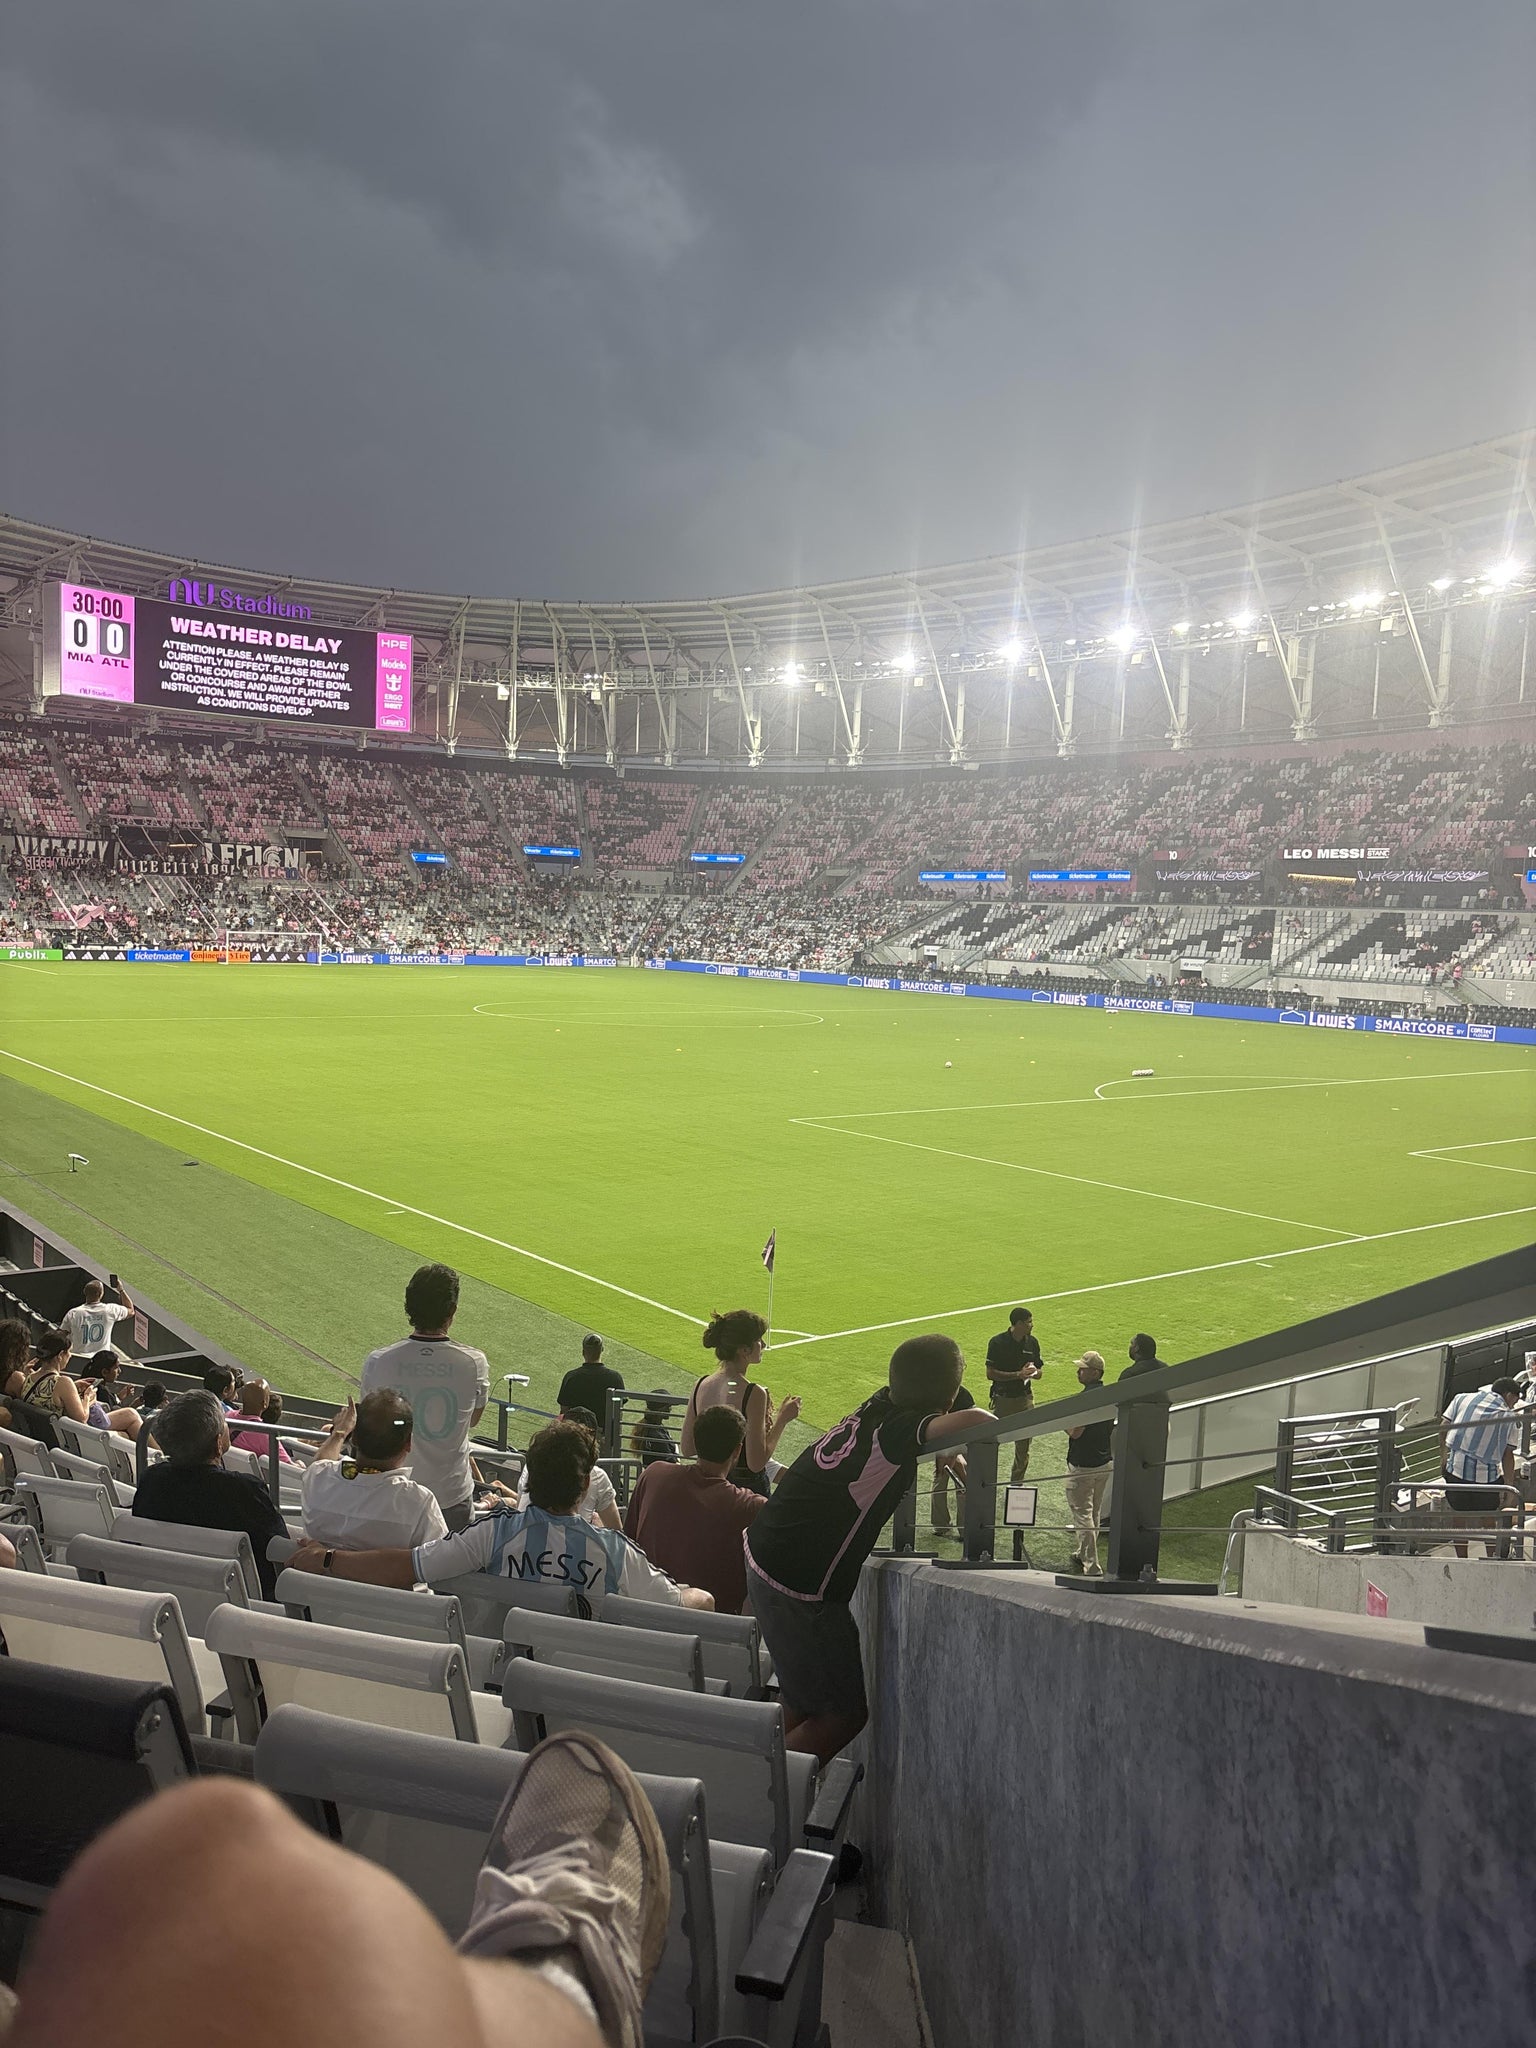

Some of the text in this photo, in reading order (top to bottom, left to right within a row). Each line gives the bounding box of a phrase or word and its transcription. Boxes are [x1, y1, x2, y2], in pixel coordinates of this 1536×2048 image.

[73, 591, 123, 620] 30:00
[220, 588, 312, 620] Stadium
[73, 618, 88, 648] 0
[106, 623, 124, 655] 0
[170, 616, 342, 654] WEATHER DELAY
[381, 639, 408, 650] HPE
[67, 651, 94, 664] MIA
[101, 658, 130, 668] ATL
[162, 640, 216, 656] ATTENTION
[255, 653, 262, 662] A
[263, 654, 308, 667] WEATHER
[309, 660, 340, 671] DELAY
[340, 663, 350, 672] IS
[166, 650, 346, 680] CURRENTLY IN EFFECT. PLEASE REMAIN
[381, 658, 407, 670] Modelo
[159, 660, 352, 692] UNDER THE COVERED AREAS OF THE BOWL
[170, 672, 341, 700] OR CONCOURSE AND AWAIT FURTHER
[161, 680, 350, 711] INSTRUCTION. WE WILL PROVIDE UPDATES
[196, 696, 314, 716] AS CONDITIONS DEVELOP.
[26, 857, 51, 870] SIEGE
[1168, 850, 1178, 860] 10
[1283, 849, 1312, 860] LEO
[1317, 848, 1365, 860] MESSI
[163, 861, 199, 875] CITY
[9, 950, 46, 960] Publix
[134, 950, 184, 960] ticketmaster
[340, 953, 374, 964] LOWE'S
[389, 955, 441, 964] SMARTCORE
[544, 957, 574, 966] LOWE'S
[584, 958, 616, 966] SMARTCO
[718, 965, 738, 976] LOWE'S
[748, 970, 783, 980] SMARTCORE
[864, 976, 890, 990] LOWE'S
[900, 981, 944, 993] SMARTCORE
[1053, 991, 1088, 1006] LOWE'S
[1104, 996, 1164, 1011] SMARTCORE
[1309, 1011, 1357, 1030] LOWE'S
[1375, 1018, 1456, 1036] SMARTCORE
[81, 1324, 104, 1344] 10
[508, 1551, 603, 1590] MESSI
